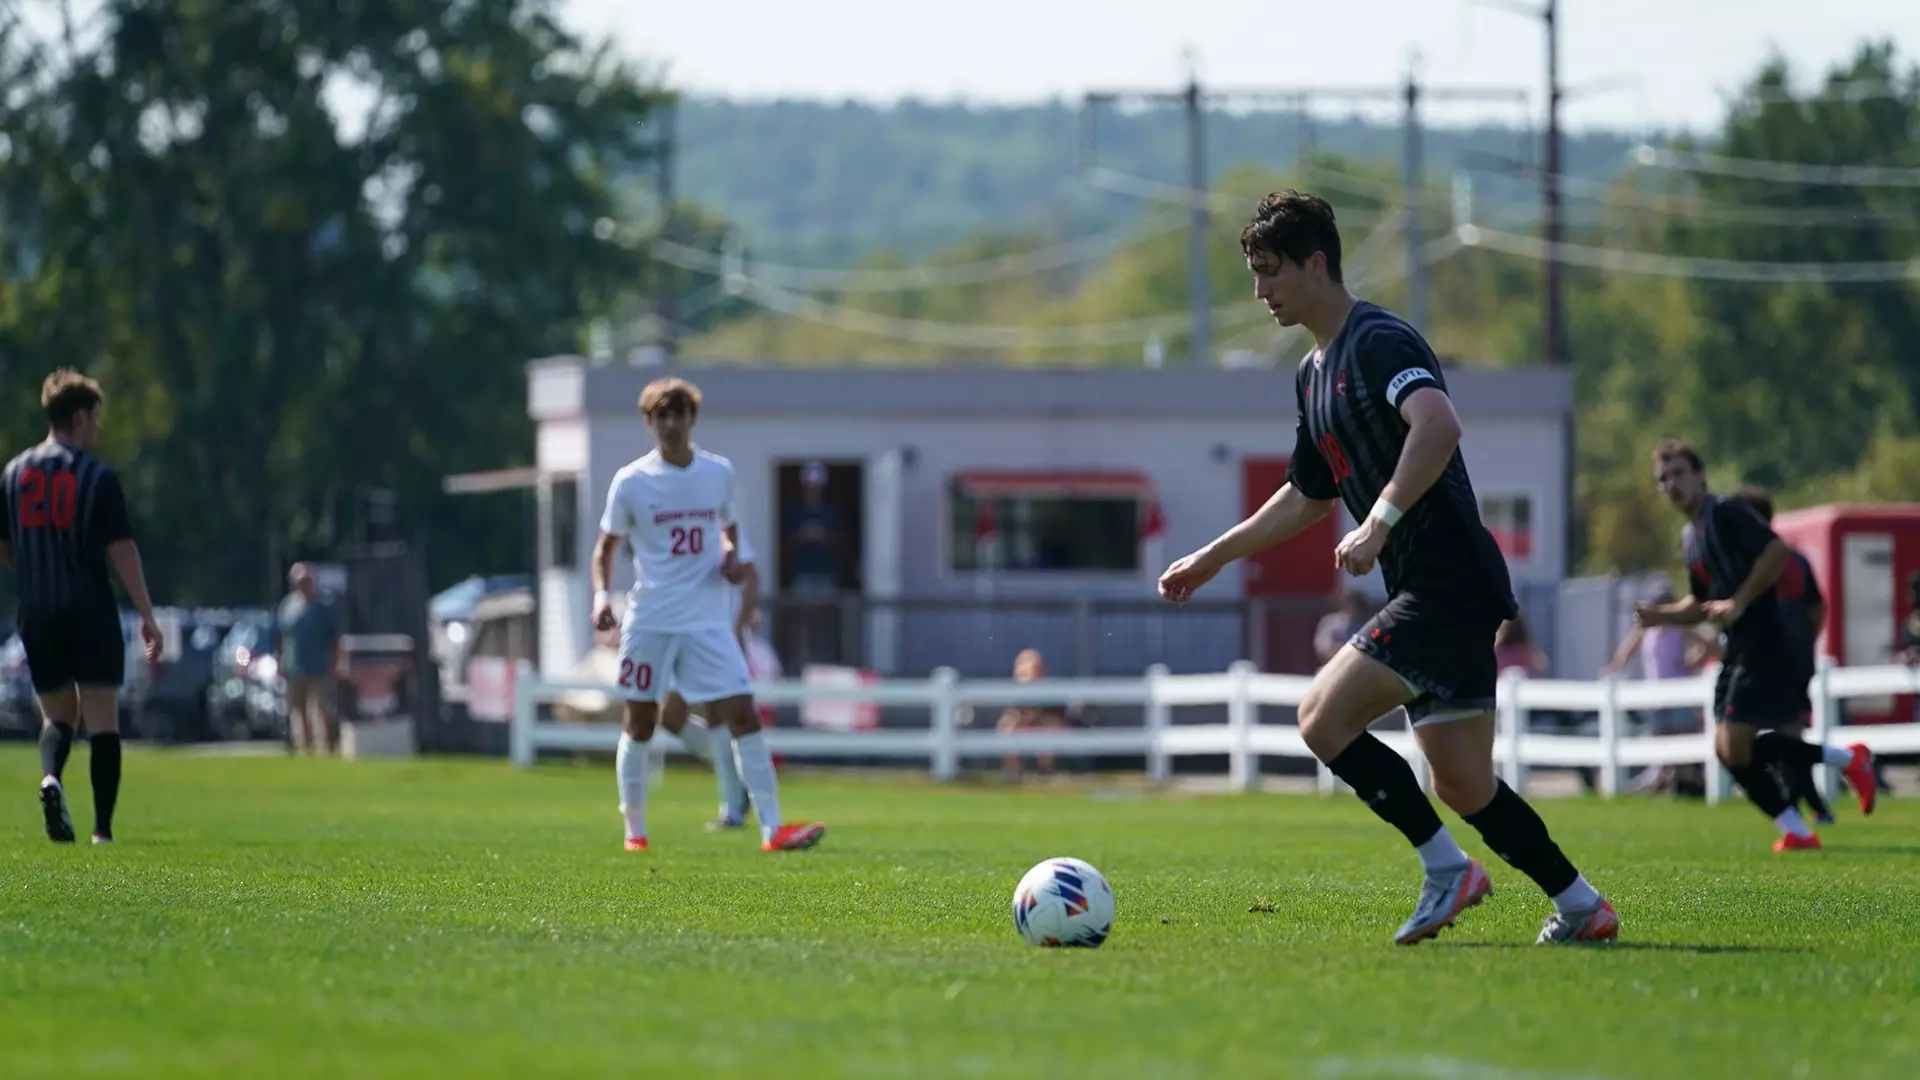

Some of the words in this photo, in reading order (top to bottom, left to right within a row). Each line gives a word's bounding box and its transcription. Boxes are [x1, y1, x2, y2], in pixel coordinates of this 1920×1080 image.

[1392, 368, 1430, 389] CAPTA
[19, 466, 77, 530] 20
[671, 526, 703, 555] 20
[619, 657, 653, 692] 20
